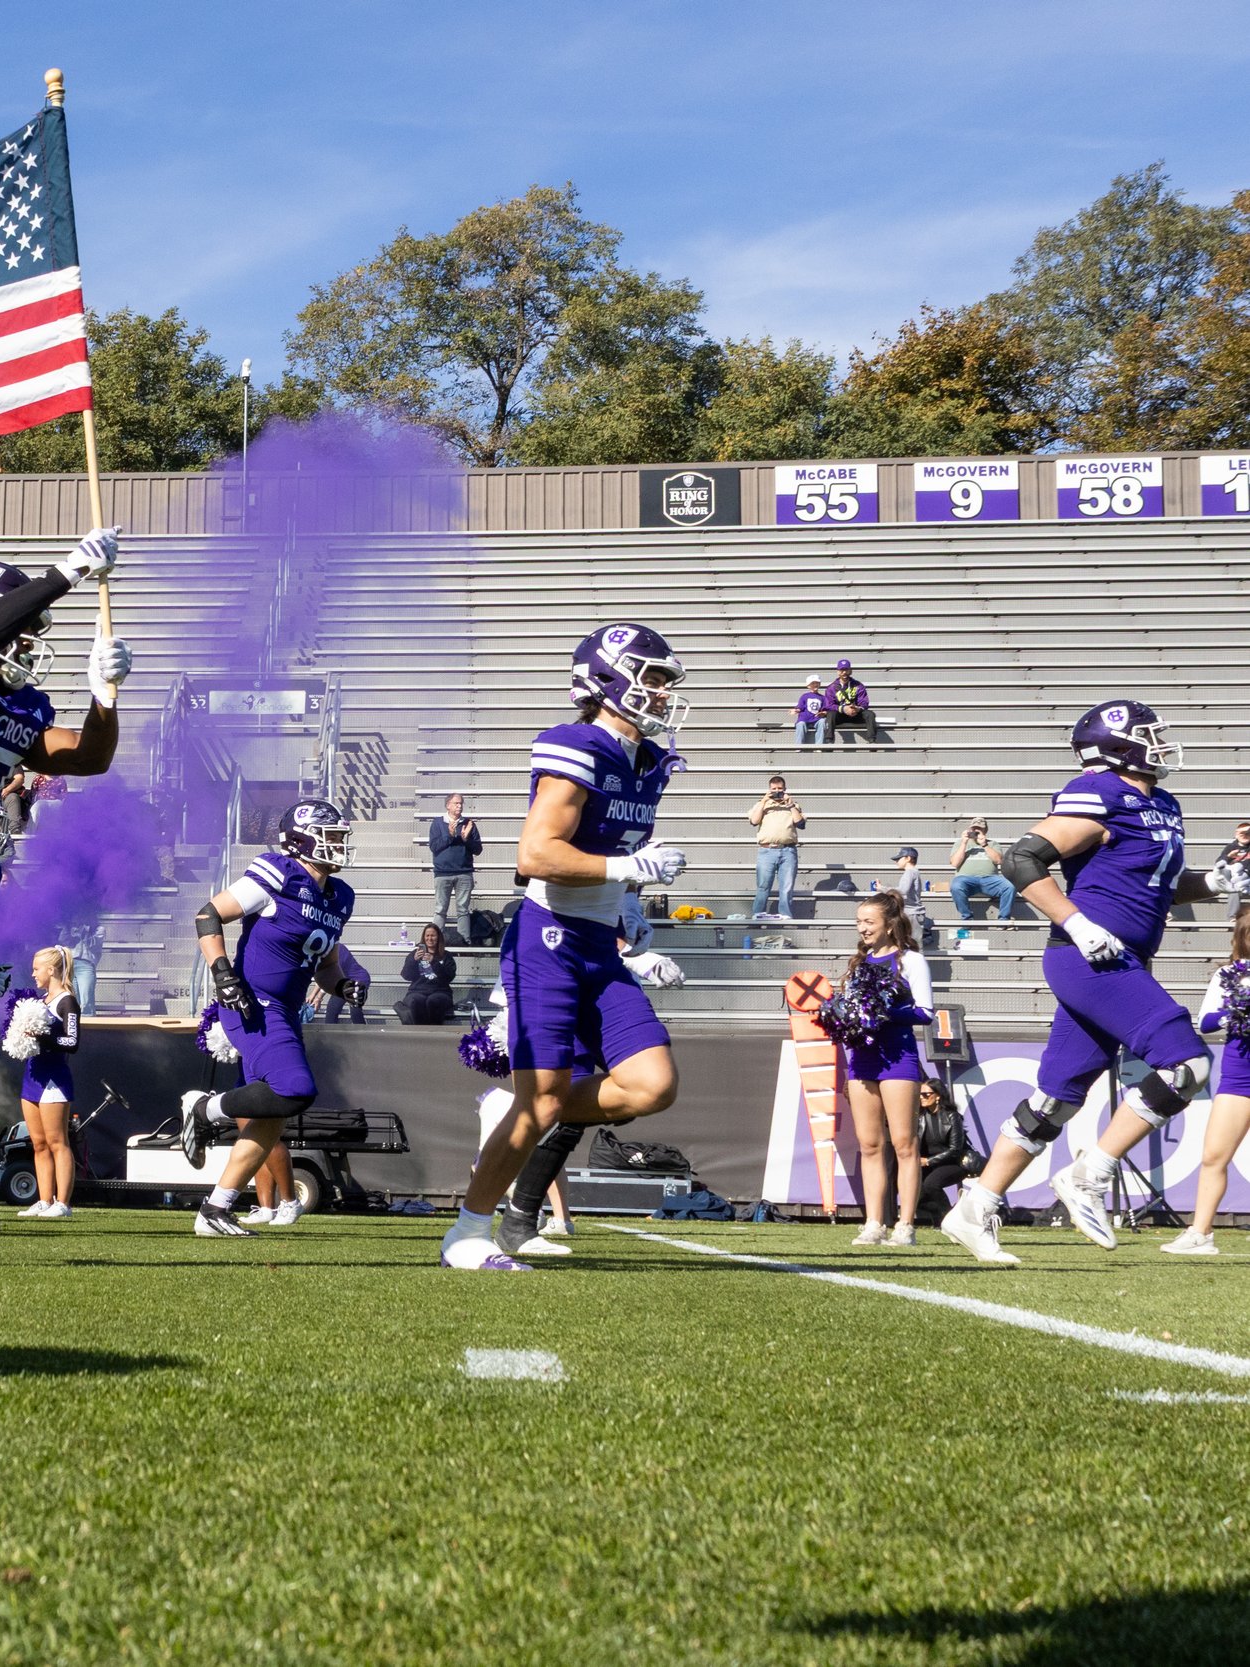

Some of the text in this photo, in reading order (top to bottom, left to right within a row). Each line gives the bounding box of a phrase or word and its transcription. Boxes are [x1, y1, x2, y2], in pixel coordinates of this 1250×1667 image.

[795, 468, 857, 480] McCABE
[923, 465, 1009, 478] McGOVERN
[1065, 462, 1153, 475] McGOVERN
[1229, 459, 1250, 471] LE
[669, 490, 708, 501] RING
[794, 483, 860, 522] 55
[949, 479, 983, 519] 9
[1078, 476, 1144, 516] 58
[669, 506, 708, 516] HONOR
[606, 799, 656, 824] HOLY CROS
[301, 903, 342, 930] HOLY CROSS
[300, 928, 336, 972] 9
[934, 1010, 953, 1039] 1
